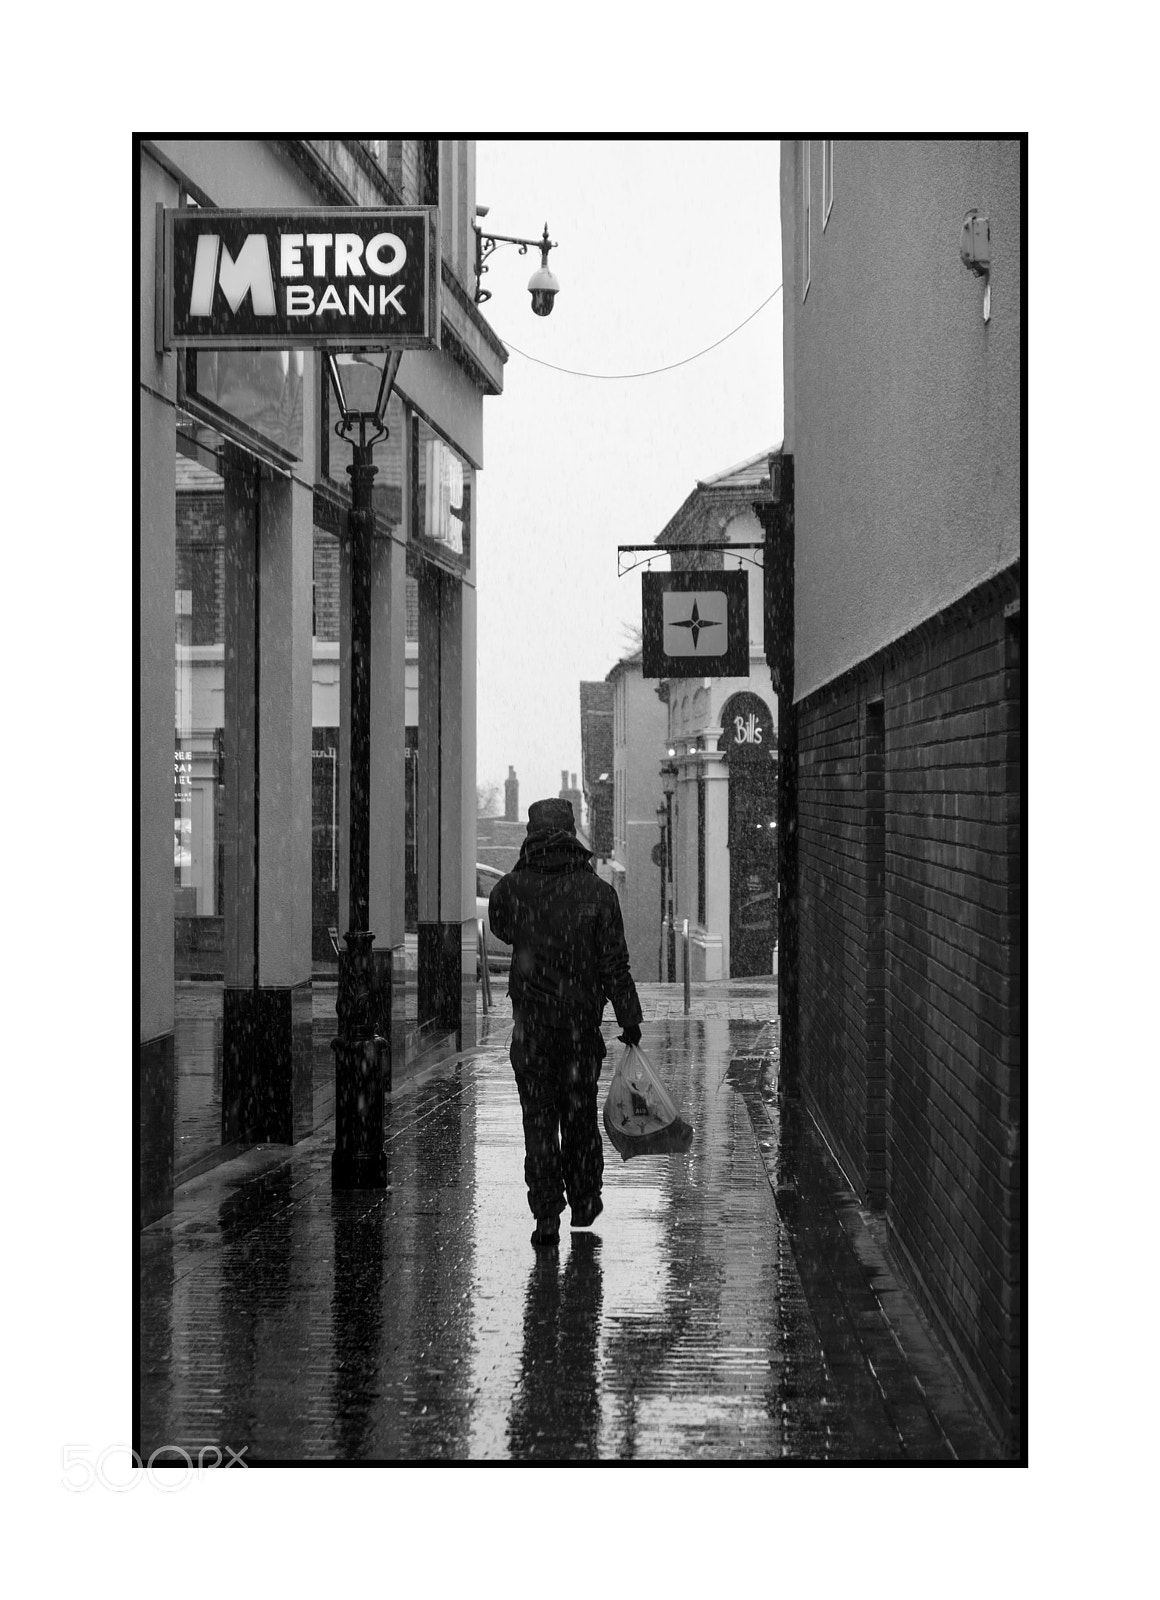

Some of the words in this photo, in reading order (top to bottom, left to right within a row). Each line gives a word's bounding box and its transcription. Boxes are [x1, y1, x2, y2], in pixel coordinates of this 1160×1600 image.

[189, 232, 407, 316] METRO
[286, 284, 407, 316] BANK
[734, 713, 762, 743] Bill's
